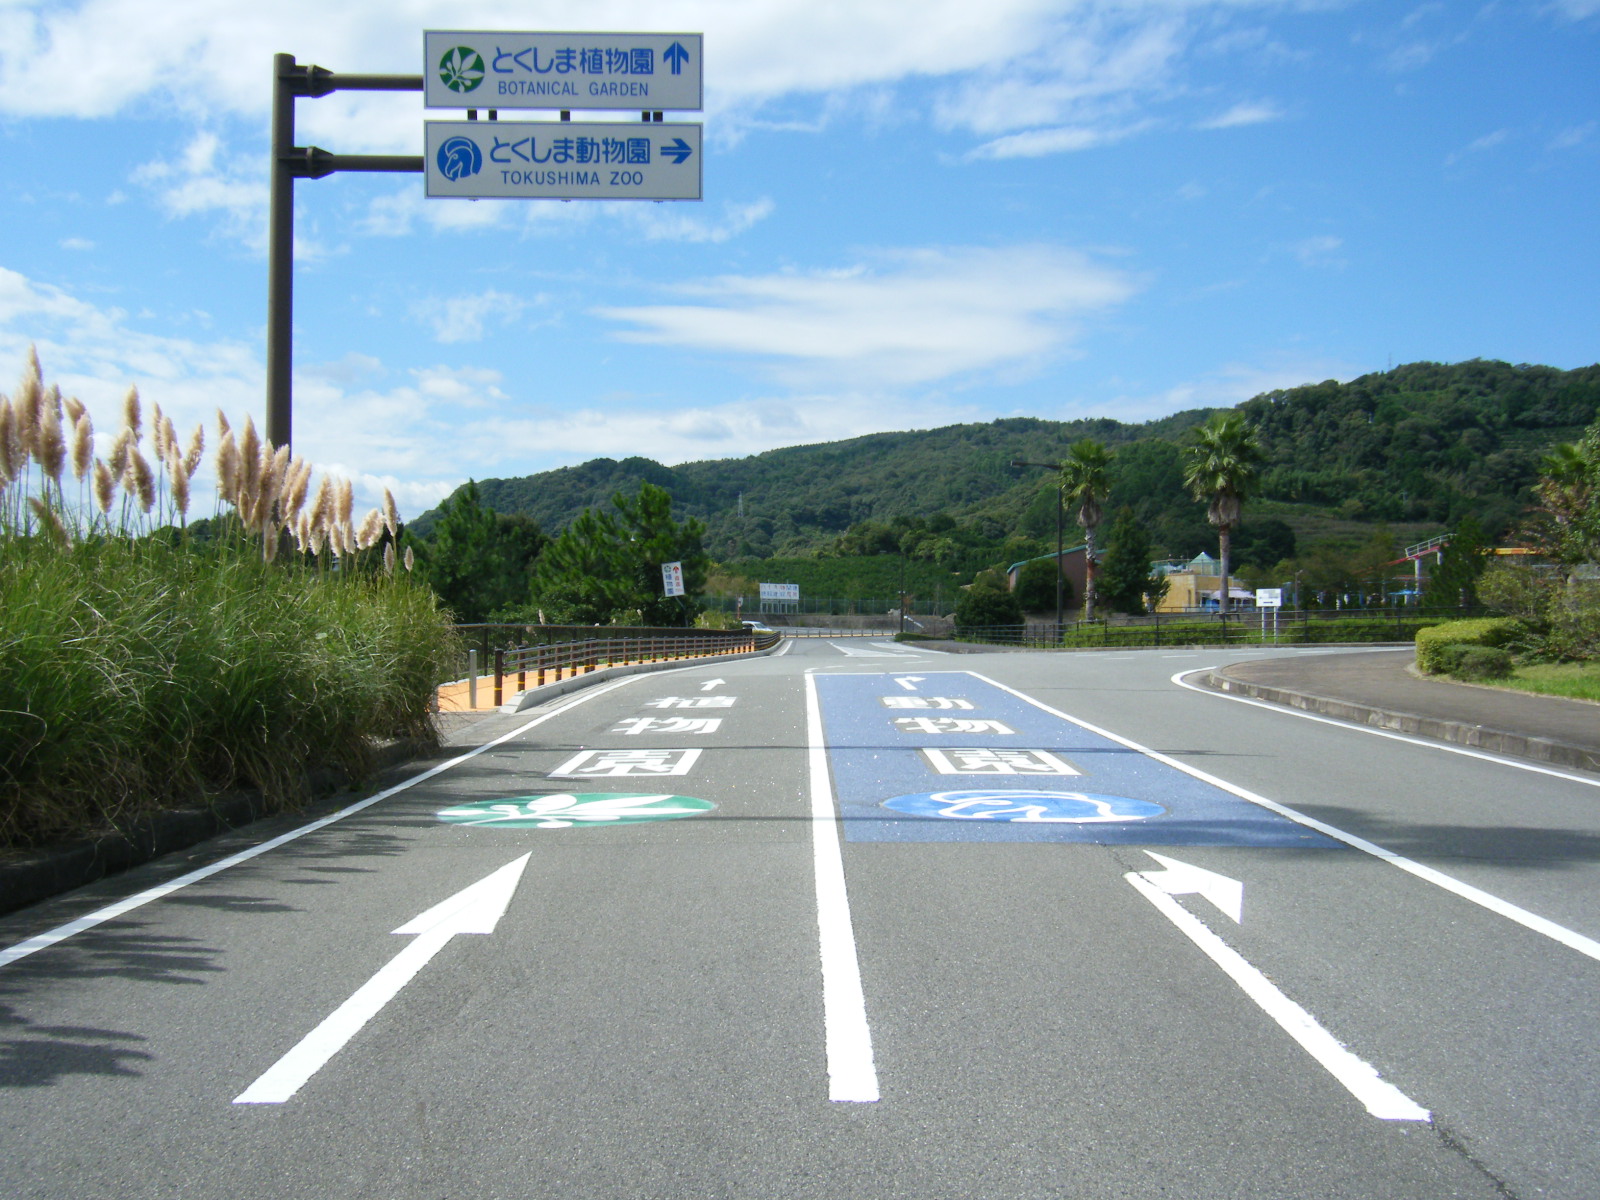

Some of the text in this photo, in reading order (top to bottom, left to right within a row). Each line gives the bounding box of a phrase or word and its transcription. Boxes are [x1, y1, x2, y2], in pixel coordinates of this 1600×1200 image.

[492, 47, 653, 74] とくしま植物園
[498, 81, 648, 96] BOTANICAL GARDEN
[490, 137, 650, 164] とくしま動物園
[501, 171, 643, 185] TOKUSHIMA ZOO
